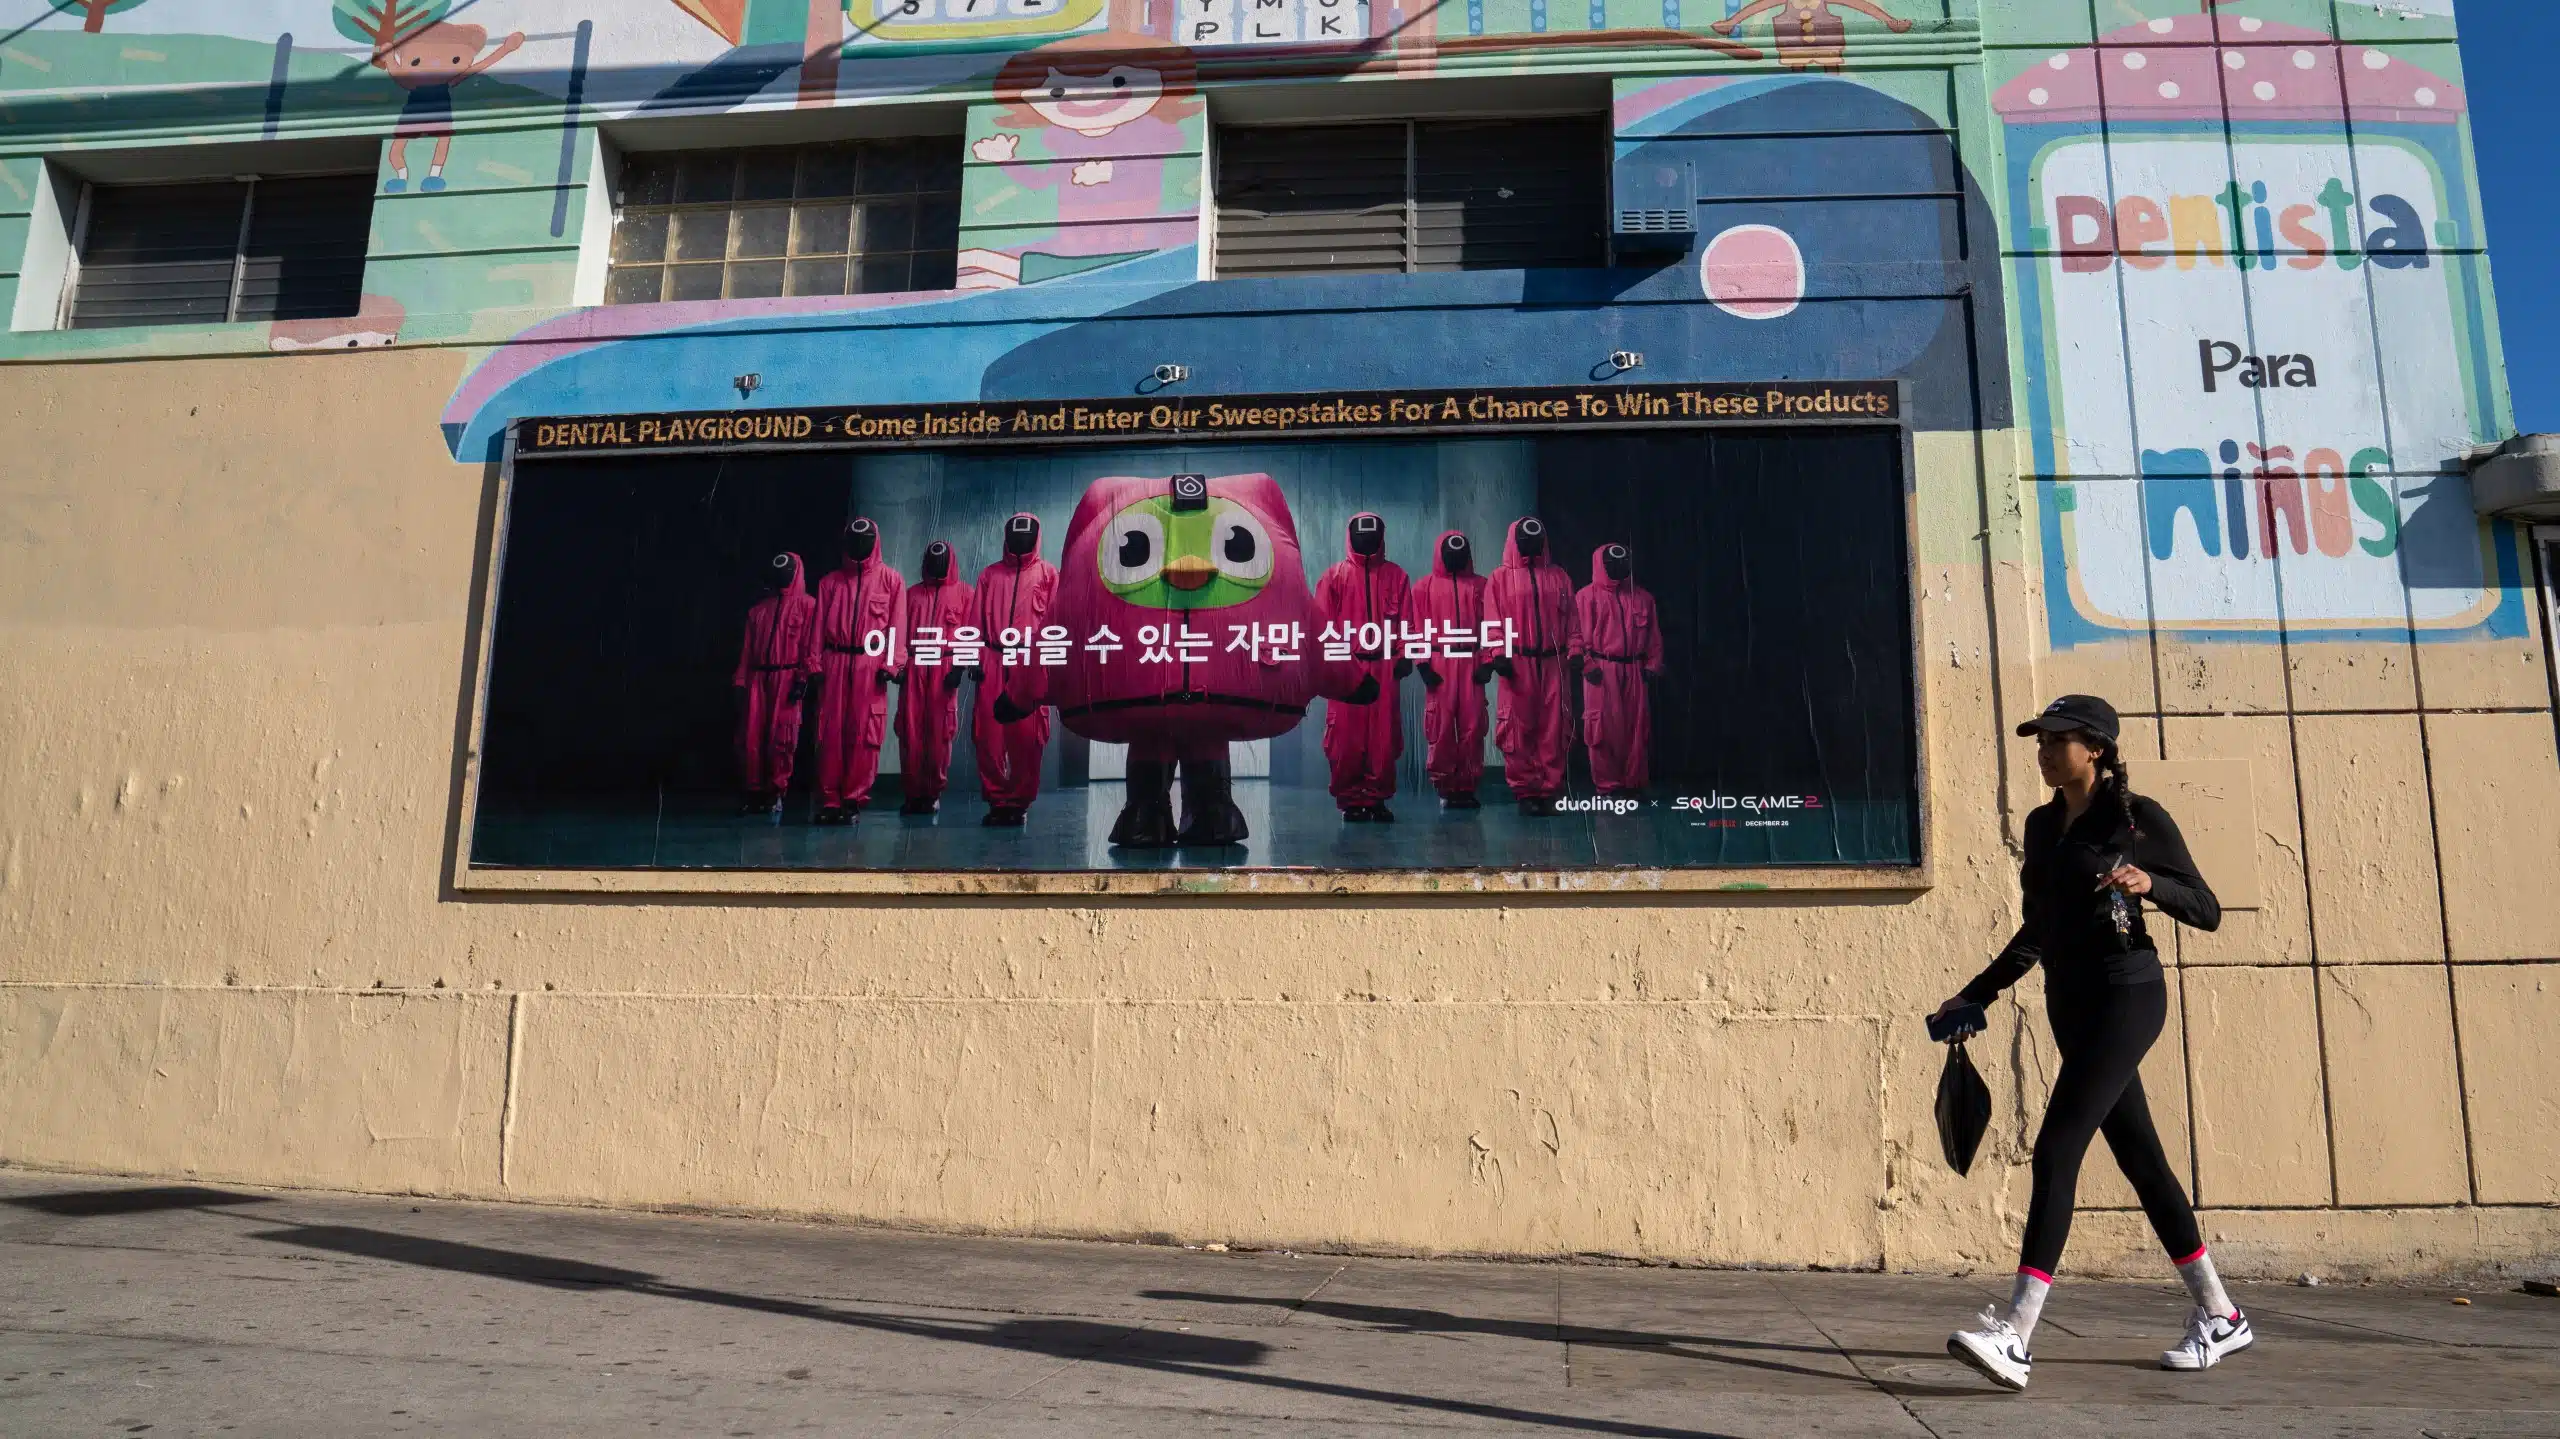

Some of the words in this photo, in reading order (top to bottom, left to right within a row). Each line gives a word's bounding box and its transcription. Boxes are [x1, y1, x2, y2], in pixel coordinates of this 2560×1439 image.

[1195, 21, 1219, 41] P
[1256, 23, 1281, 38] L
[1321, 15, 1342, 35] K
[2055, 178, 2430, 273] Dentista
[2199, 339, 2317, 393] Para
[537, 422, 631, 446] DENTAL
[638, 415, 811, 443] PLAYGROUND
[845, 413, 917, 437] Come
[924, 410, 1001, 435] Inside
[1012, 408, 1065, 432] And
[1073, 407, 1144, 431] Enter
[1150, 405, 1200, 429] Our
[1208, 399, 1382, 430] Sweepstakes
[1389, 399, 1434, 422] For
[1442, 397, 1460, 420] A
[1468, 395, 1569, 420] Chance
[1575, 394, 1608, 417] To
[1616, 392, 1670, 416] Win
[1676, 391, 1758, 415] These
[1766, 389, 1889, 414] Products
[2141, 438, 2399, 561] niños
[864, 626, 896, 667] 이
[910, 626, 985, 666] 글을
[999, 625, 1073, 666] 읽을
[1084, 624, 1123, 664] 수
[1138, 623, 1213, 663] 있는
[1225, 620, 1305, 661] 자만
[1317, 617, 1518, 662] 살아남는다
[1555, 795, 1639, 815] duolingo
[1671, 789, 1738, 814] SQUID
